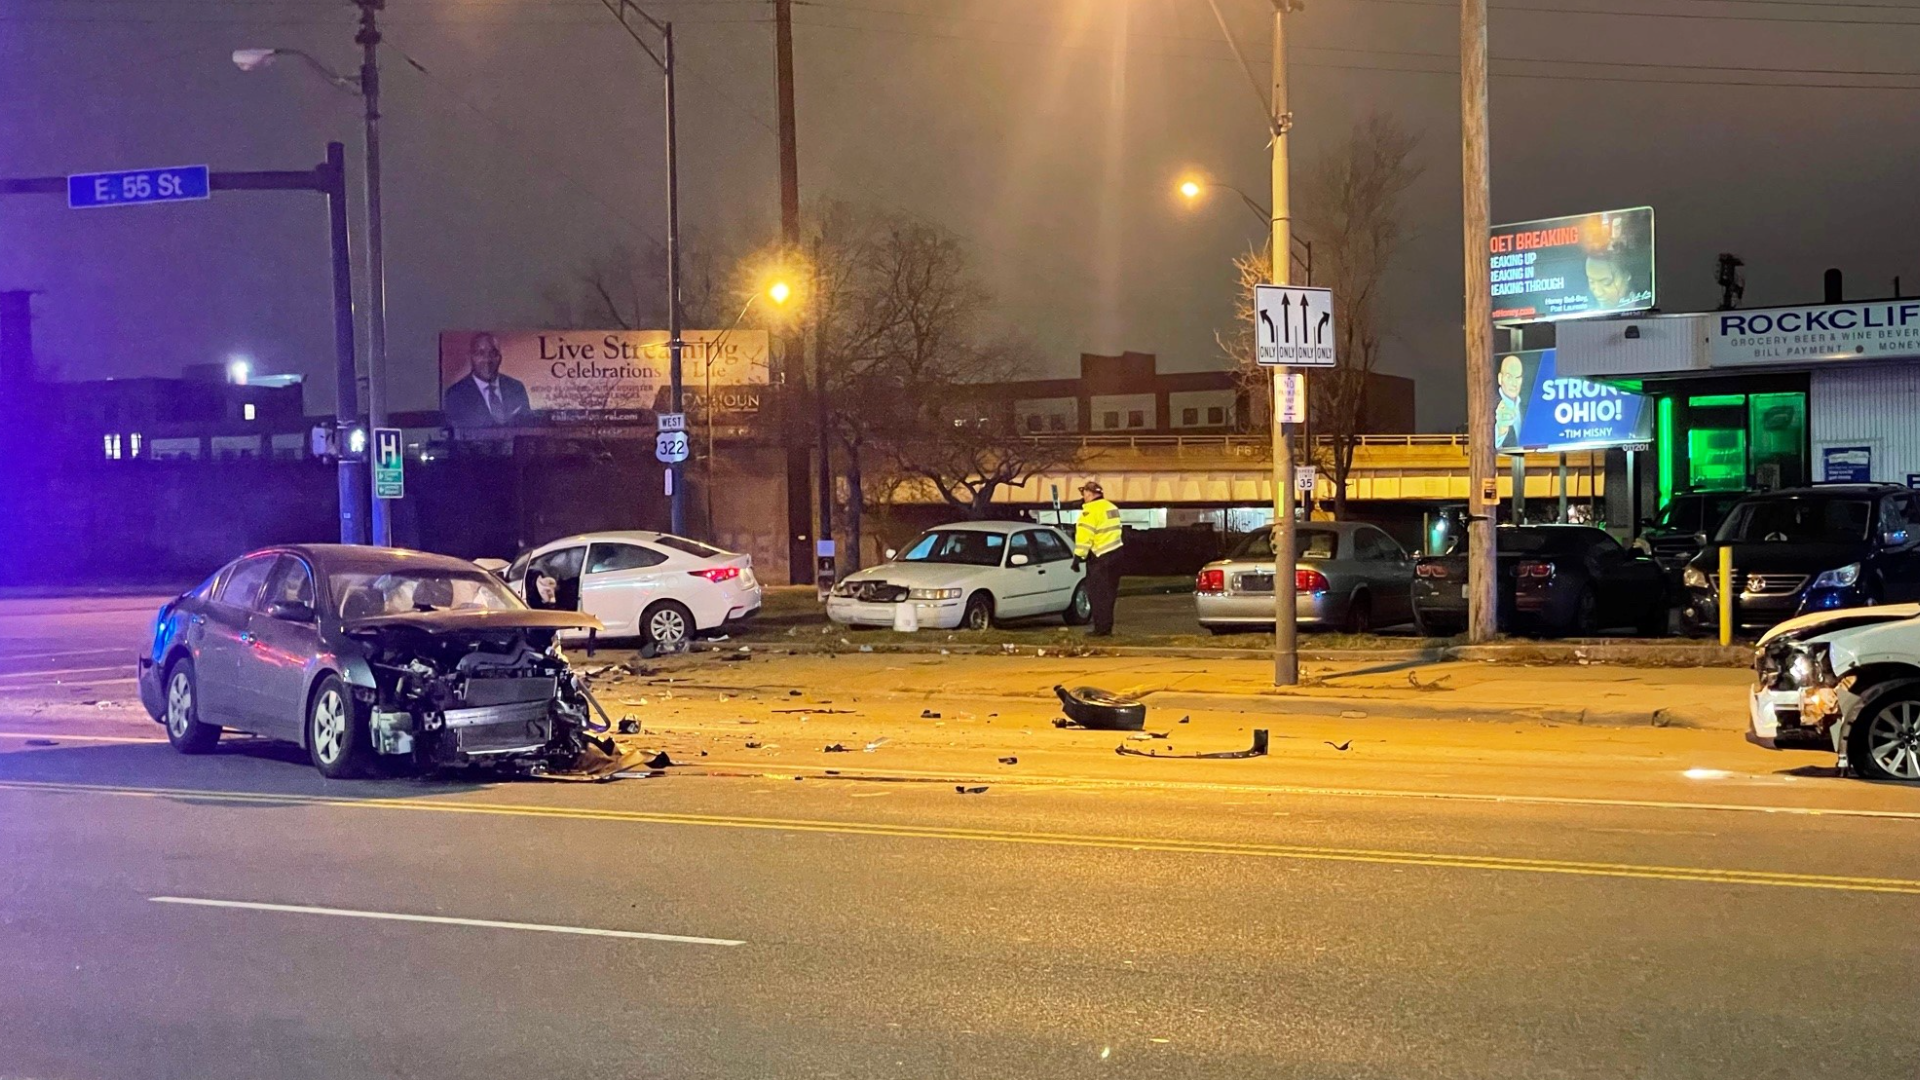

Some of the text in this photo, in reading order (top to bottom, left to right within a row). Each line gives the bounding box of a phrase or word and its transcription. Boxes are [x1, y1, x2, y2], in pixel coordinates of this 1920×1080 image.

[95, 173, 183, 201] E. 55 St
[1515, 226, 1579, 250] BREAKING
[1524, 252, 1537, 265] UP
[1524, 266, 1534, 278] IN
[1525, 276, 1564, 293] THROUGH
[1721, 305, 1920, 336] ROCKCLIF
[1731, 336, 1787, 347] GROCERY
[1794, 334, 1825, 344] BEER
[1829, 333, 1836, 341] &
[1841, 331, 1872, 340] WINE
[538, 335, 594, 360] Live
[1260, 346, 1332, 359] ONLY ONLY ONLY ONLY
[1754, 348, 1780, 358] BILL
[1787, 345, 1841, 356] PAYMENT
[551, 361, 660, 379] Celebrations
[1542, 378, 1631, 401] STRON
[1554, 399, 1622, 424] OHIO!
[661, 416, 682, 428] WEST
[1583, 427, 1613, 438] MISNY
[380, 434, 397, 465] H
[660, 440, 685, 456] 322
[1300, 478, 1313, 488] 35
